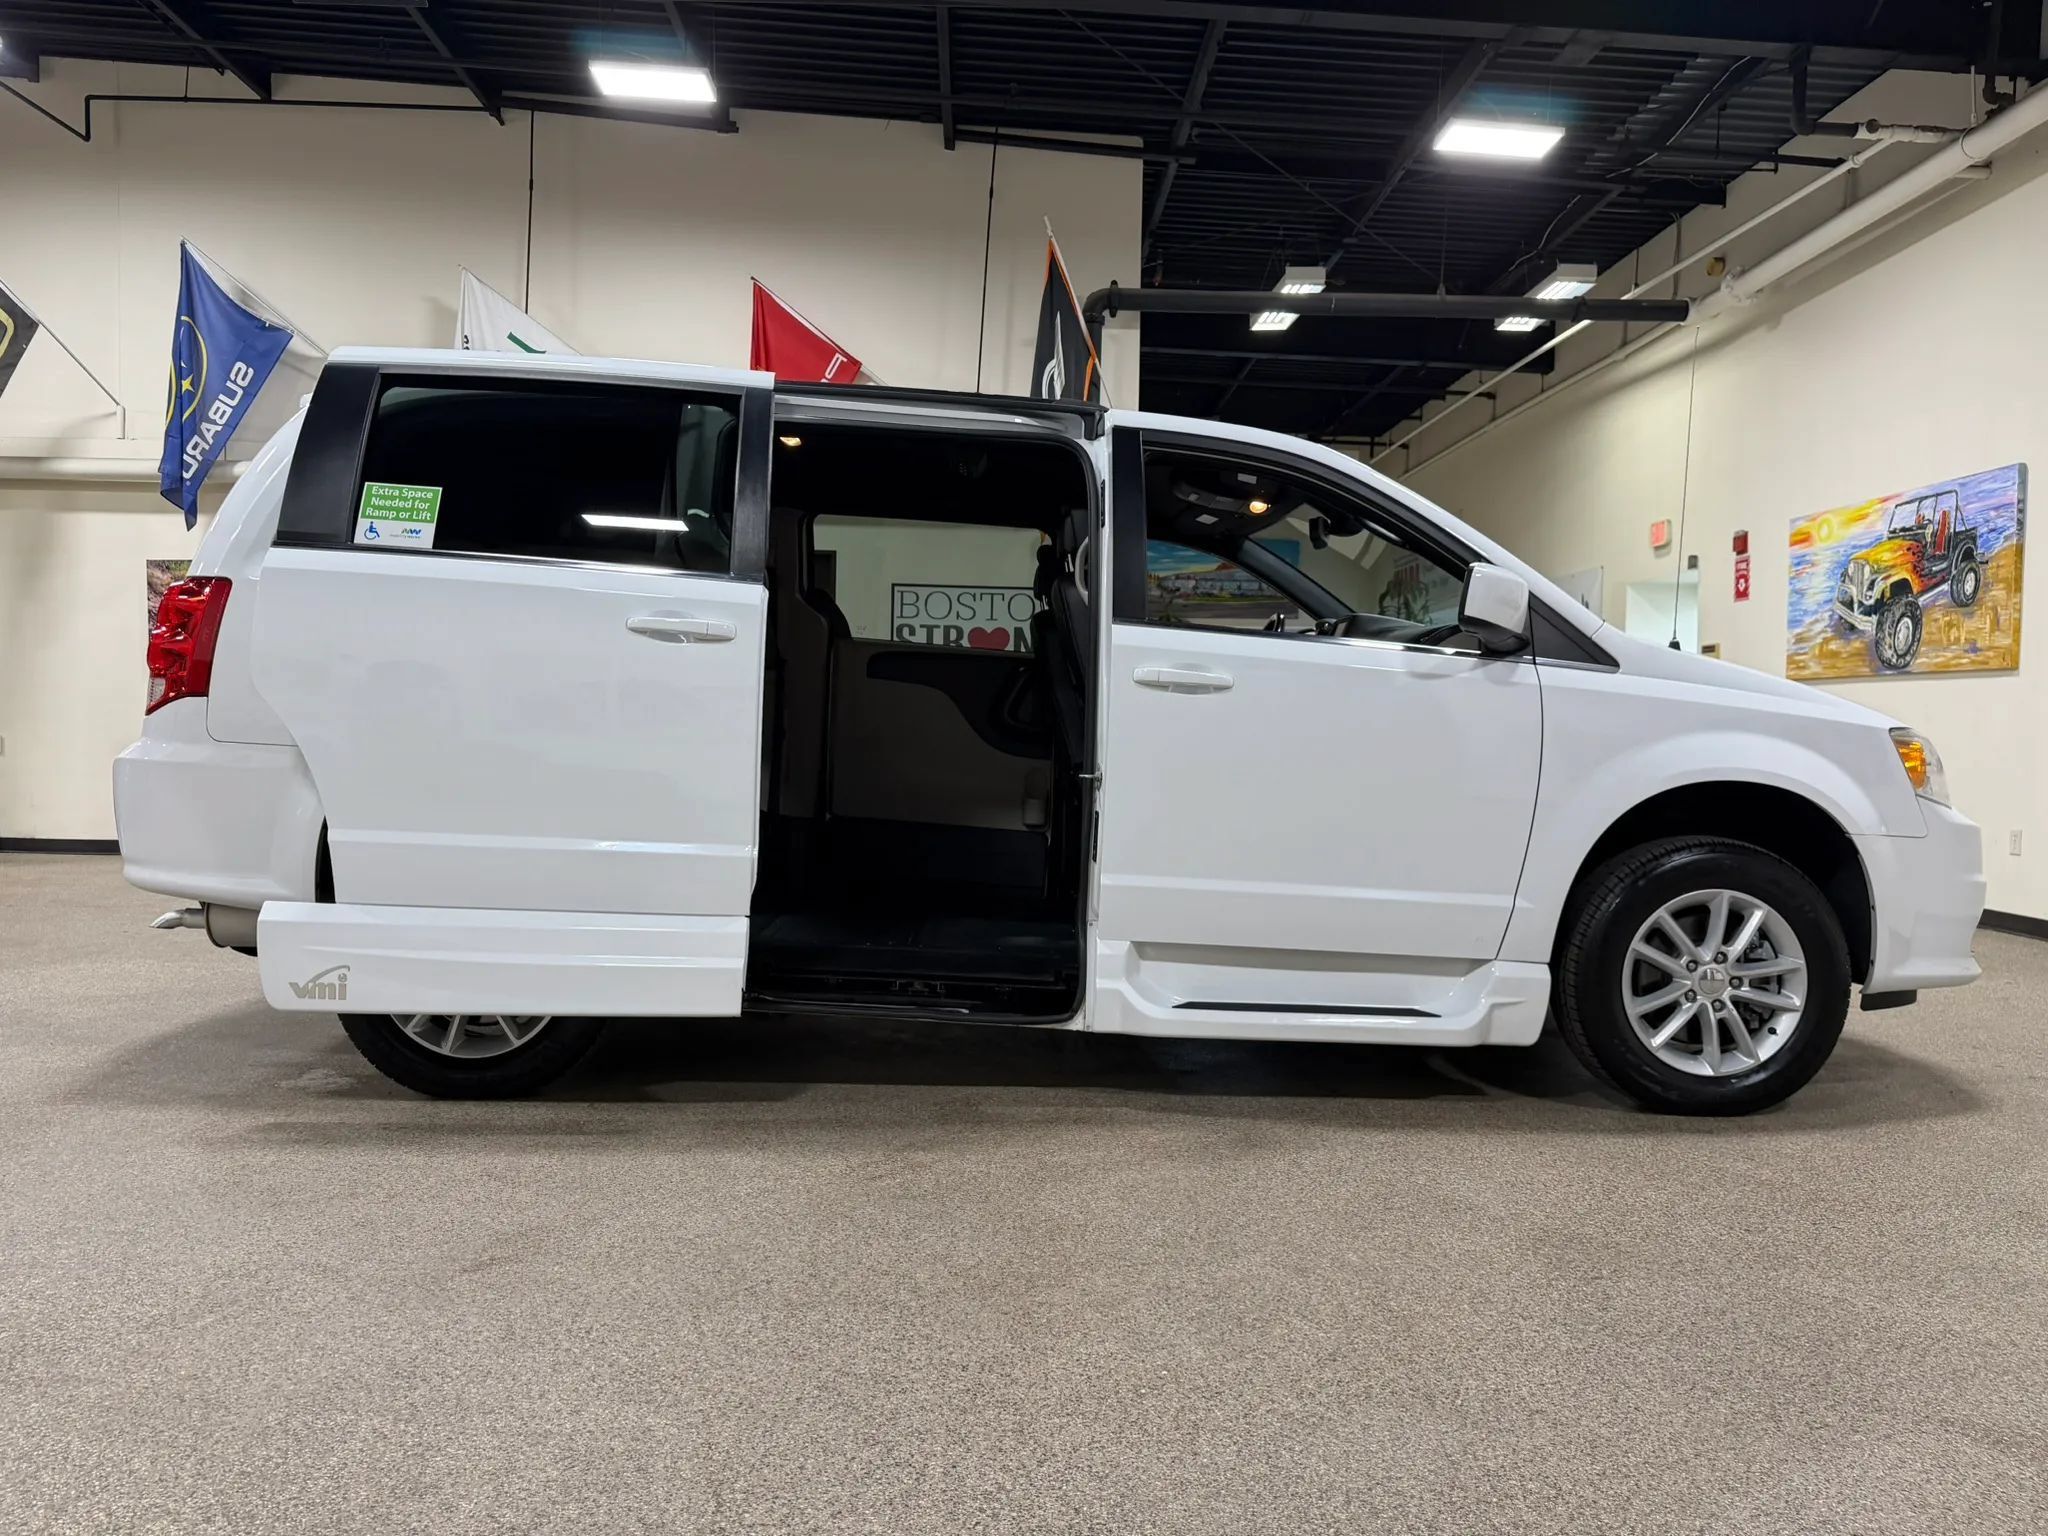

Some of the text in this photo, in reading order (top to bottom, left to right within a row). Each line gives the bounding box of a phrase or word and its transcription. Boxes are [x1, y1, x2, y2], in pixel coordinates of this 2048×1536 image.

[371, 486, 433, 499] Extra Space
[370, 497, 430, 510] Needed for
[365, 507, 432, 520] Ramp or Lift
[896, 589, 1036, 623] BOSTO
